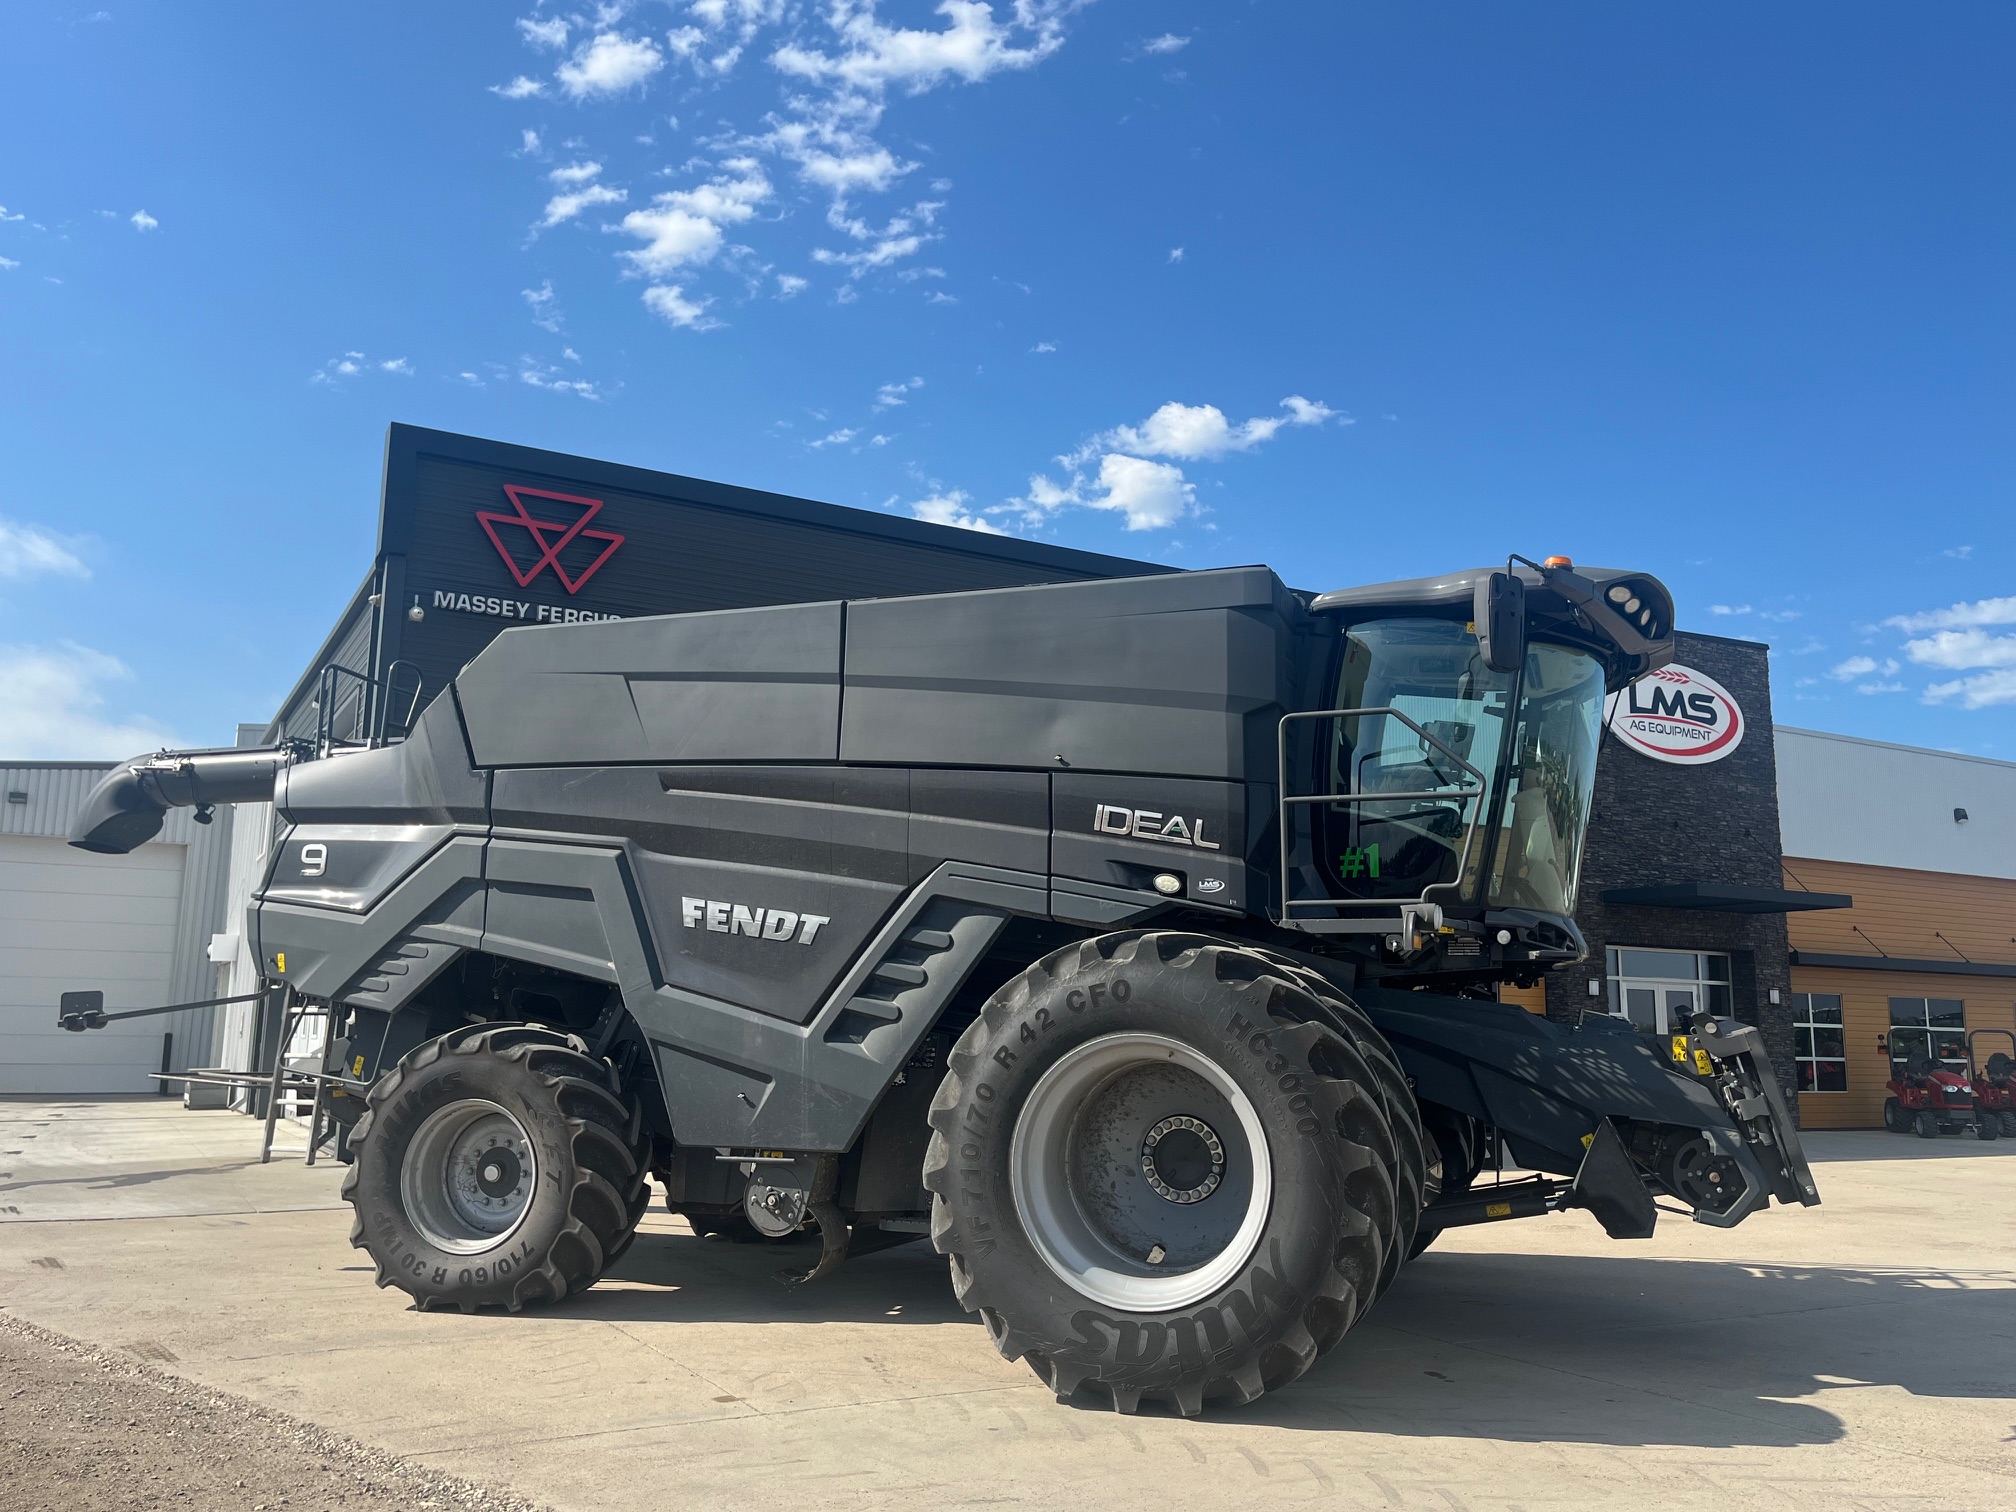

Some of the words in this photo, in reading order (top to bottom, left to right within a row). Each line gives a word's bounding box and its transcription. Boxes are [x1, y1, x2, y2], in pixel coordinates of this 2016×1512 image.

[433, 590, 530, 619] MASSEY
[536, 604, 622, 624] FERGU
[1628, 684, 1718, 726] LMS
[1630, 720, 1646, 731] AG
[1649, 723, 1712, 742] EQUIPMENT
[1093, 803, 1220, 849] IDEAL
[301, 843, 328, 877] 9
[1339, 843, 1381, 879] #1
[1199, 880, 1220, 888] LMS
[682, 896, 831, 945] FENDT
[1065, 979, 1132, 1014] CFO
[1019, 1007, 1057, 1045] 42
[993, 1045, 1019, 1071] R
[960, 1082, 997, 1207] 710/70
[966, 1214, 998, 1261] VF
[401, 1252, 427, 1278] 30
[431, 1266, 448, 1286] R
[458, 1240, 536, 1287] 710/60
[1063, 1236, 1299, 1374] Mitas
